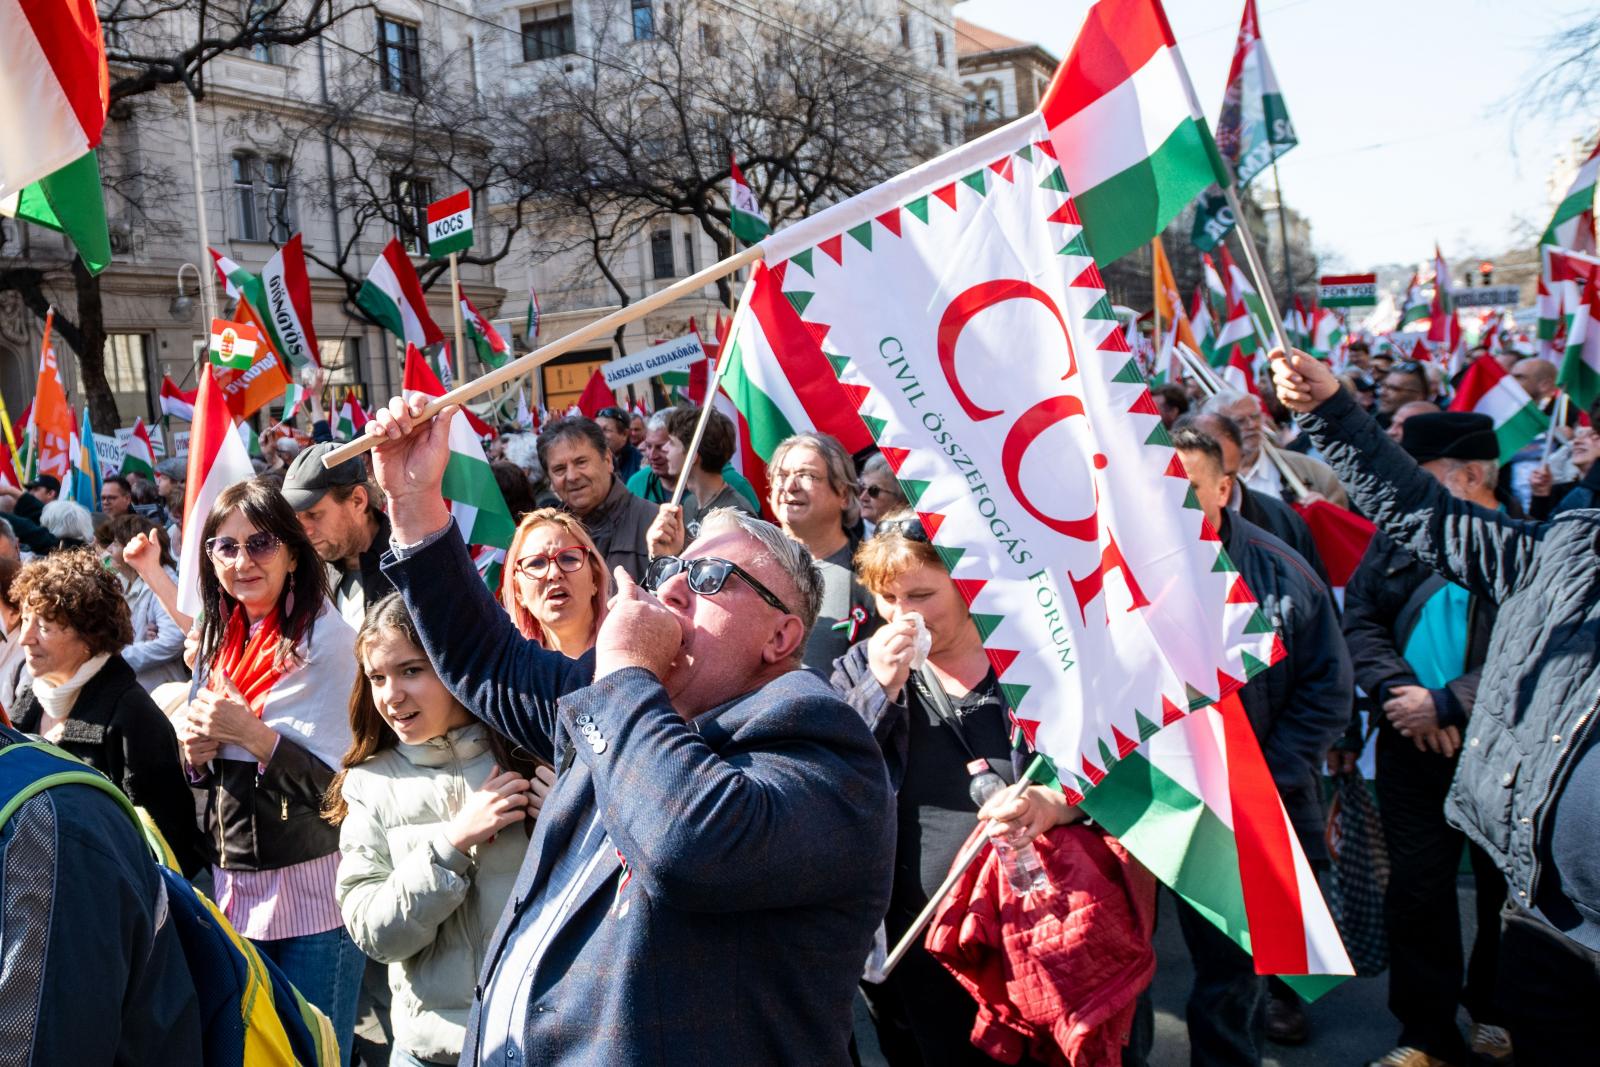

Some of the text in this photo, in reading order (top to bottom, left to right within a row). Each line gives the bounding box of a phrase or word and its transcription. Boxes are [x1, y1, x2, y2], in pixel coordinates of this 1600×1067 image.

[435, 214, 464, 238] KOCS
[269, 275, 304, 356] GYÖNGYÖS
[607, 362, 645, 383] JÁSZSÁGI
[645, 343, 701, 370] GAZDAKÖRÖK
[95, 440, 120, 460] NGYÖS
[878, 336, 1075, 672] CIVIL ÖSSZEFOGÁS FÓRUM
